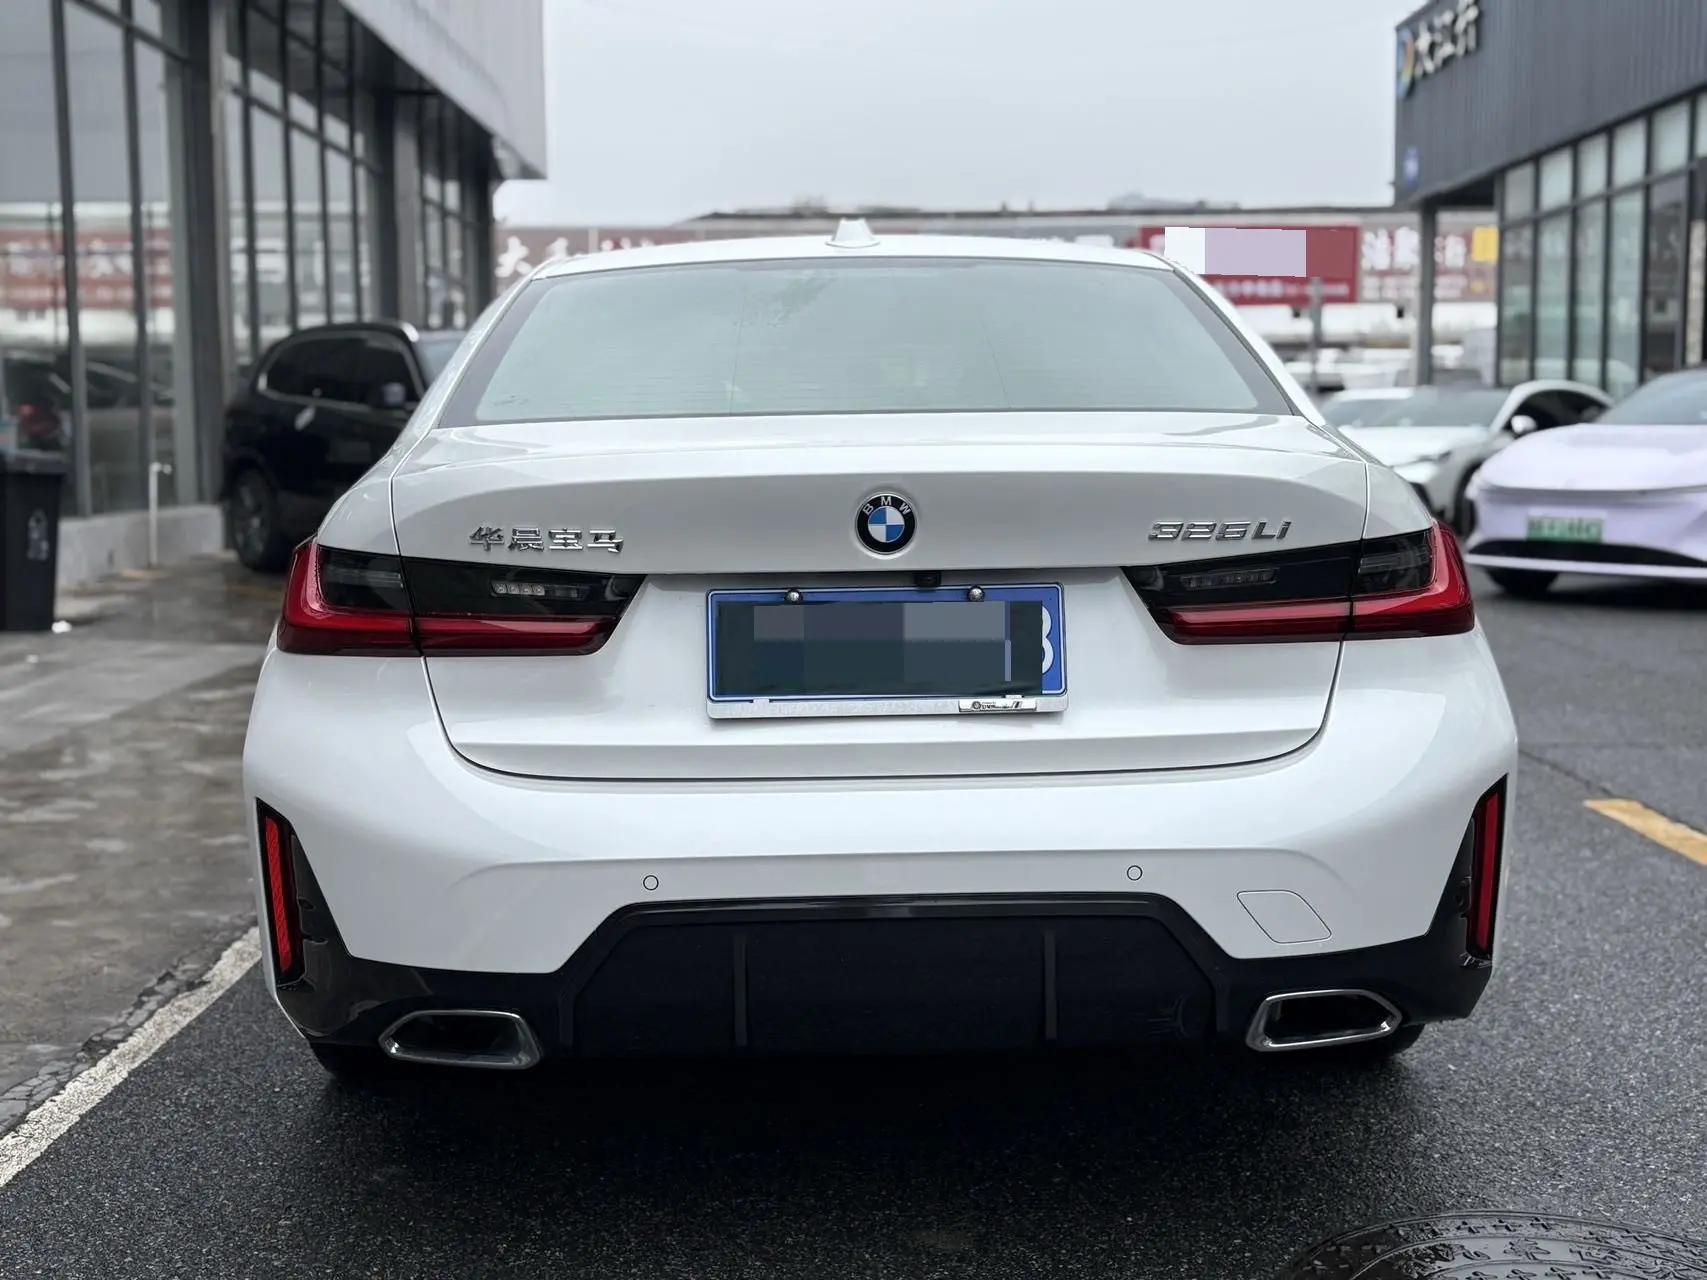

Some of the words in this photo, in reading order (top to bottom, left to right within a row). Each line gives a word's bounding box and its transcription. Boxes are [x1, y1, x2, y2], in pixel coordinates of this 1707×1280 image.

[862, 496, 911, 515] BMW
[470, 526, 624, 553] 华晨宝马
[1149, 521, 1292, 541] 325Li
